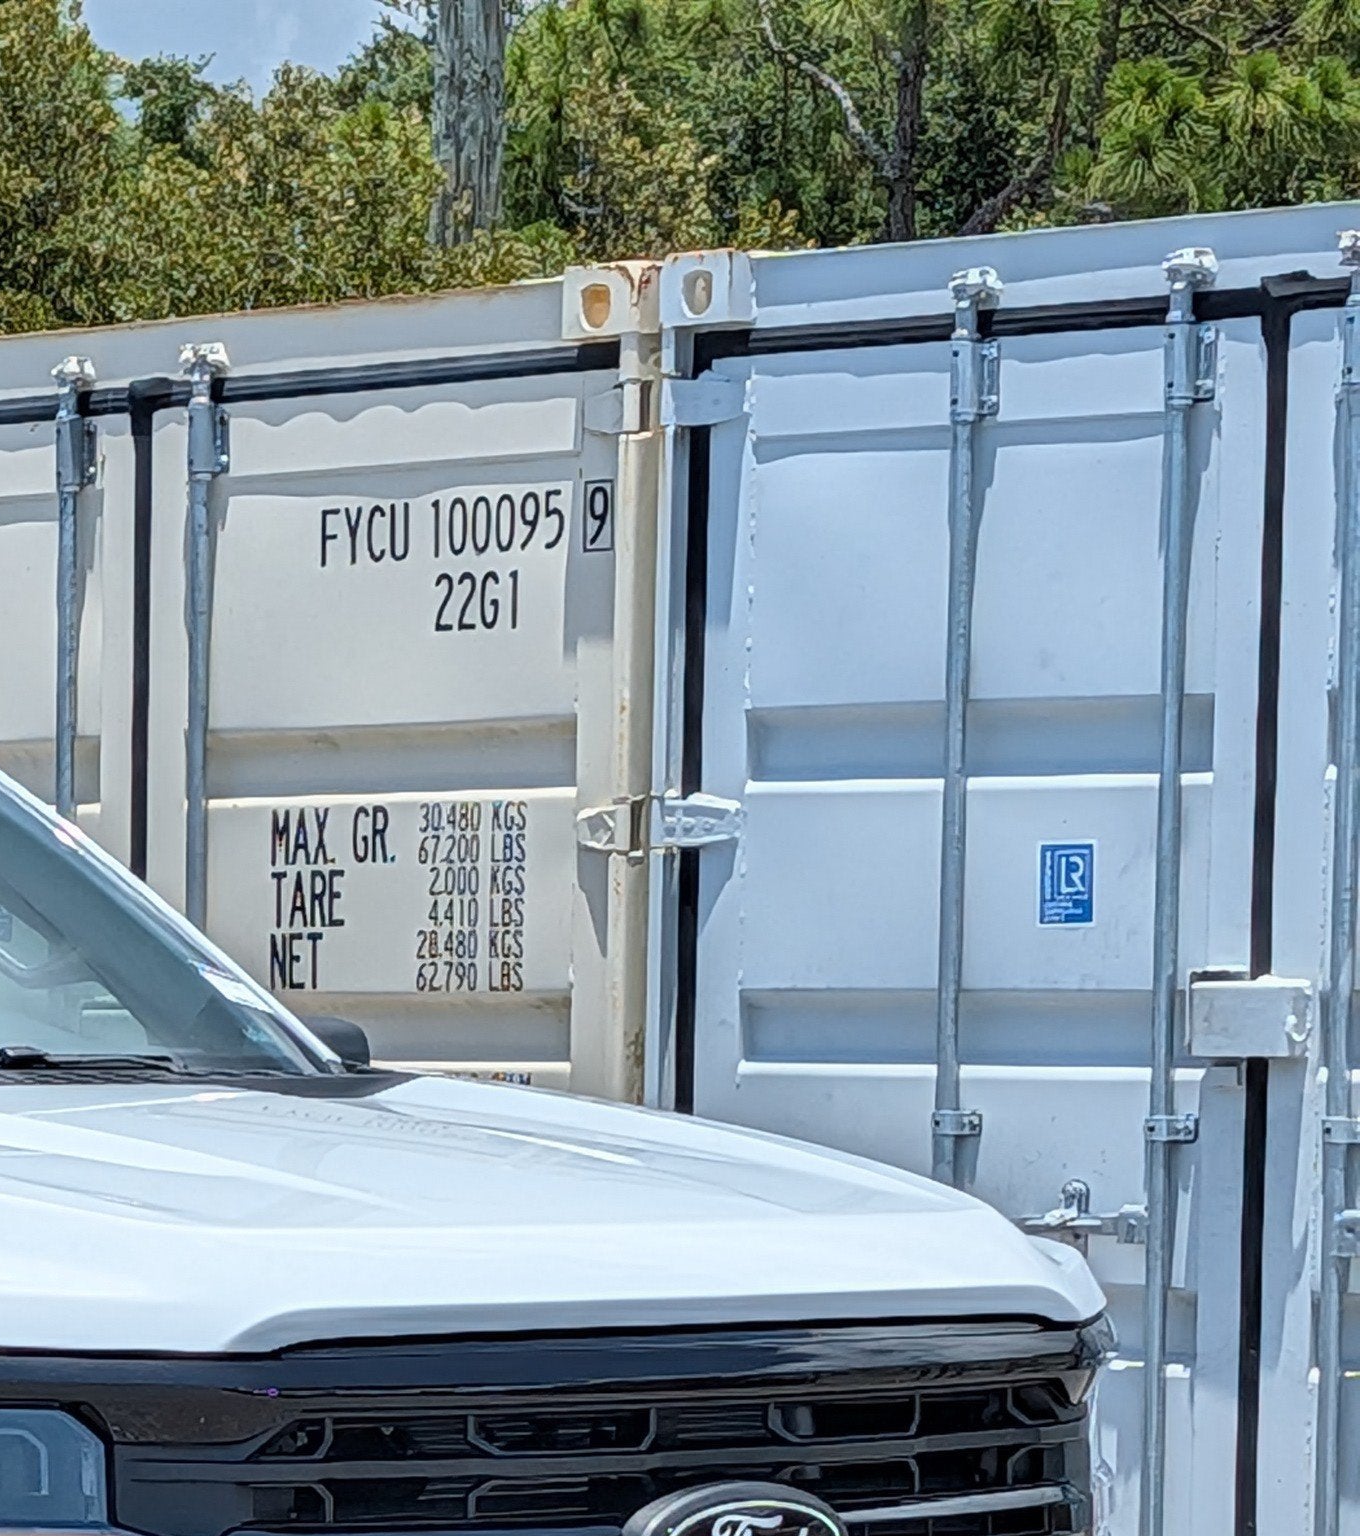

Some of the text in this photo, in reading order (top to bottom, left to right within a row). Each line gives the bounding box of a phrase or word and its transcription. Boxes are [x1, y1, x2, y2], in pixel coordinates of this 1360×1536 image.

[320, 486, 609, 568] FYCU 100095 9
[434, 569, 518, 632] 22G1
[491, 801, 527, 832] KGS
[353, 805, 396, 864] GR.
[491, 833, 526, 863] LBS
[489, 865, 526, 896] KGS
[271, 869, 345, 928] TARE
[489, 897, 525, 928] LBS
[488, 929, 524, 959] KGS
[269, 932, 323, 990] NET
[488, 961, 524, 992] LBS
